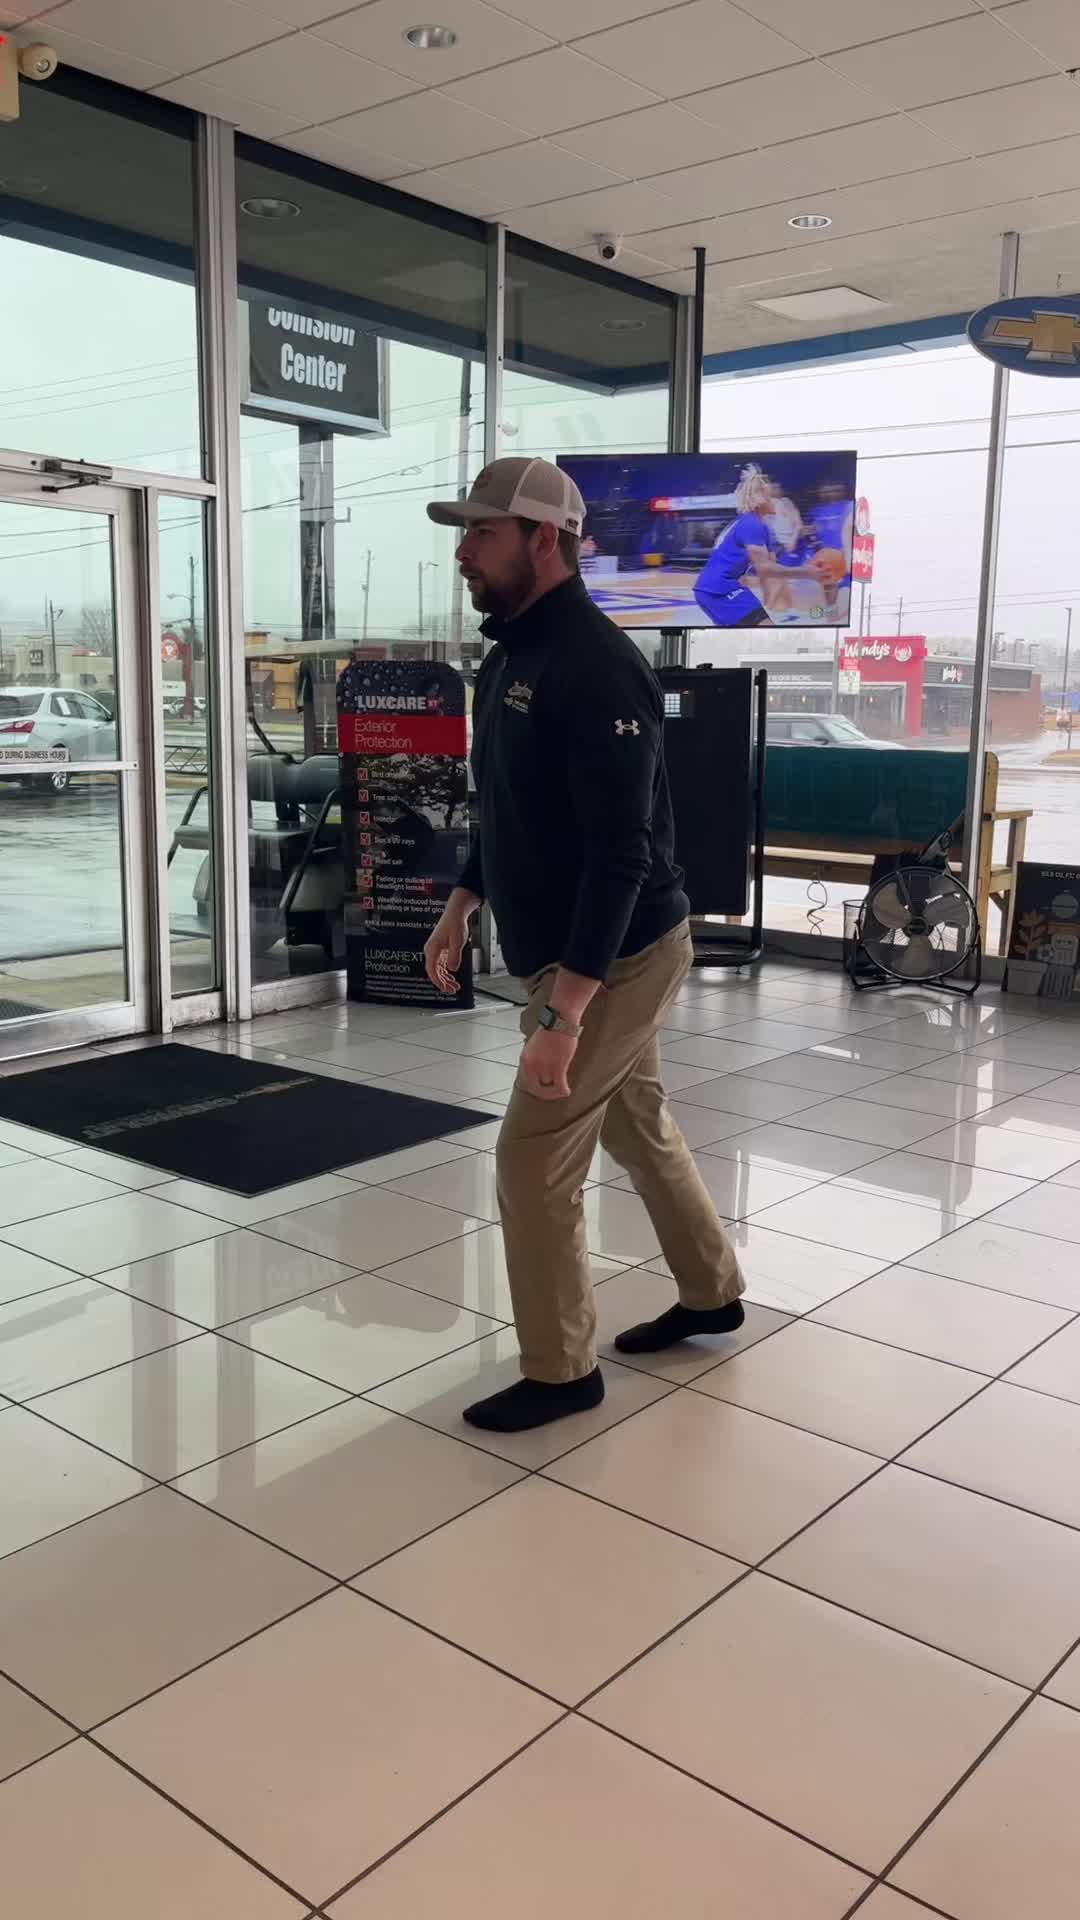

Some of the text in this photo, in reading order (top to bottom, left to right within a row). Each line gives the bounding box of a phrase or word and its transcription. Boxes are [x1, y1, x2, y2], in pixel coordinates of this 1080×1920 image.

[281, 343, 347, 392] Center
[844, 640, 891, 660] Wndy's
[357, 695, 427, 710] LUXCARE
[355, 718, 397, 733] Exterior
[355, 734, 412, 748] Protection
[364, 960, 410, 974] Protection
